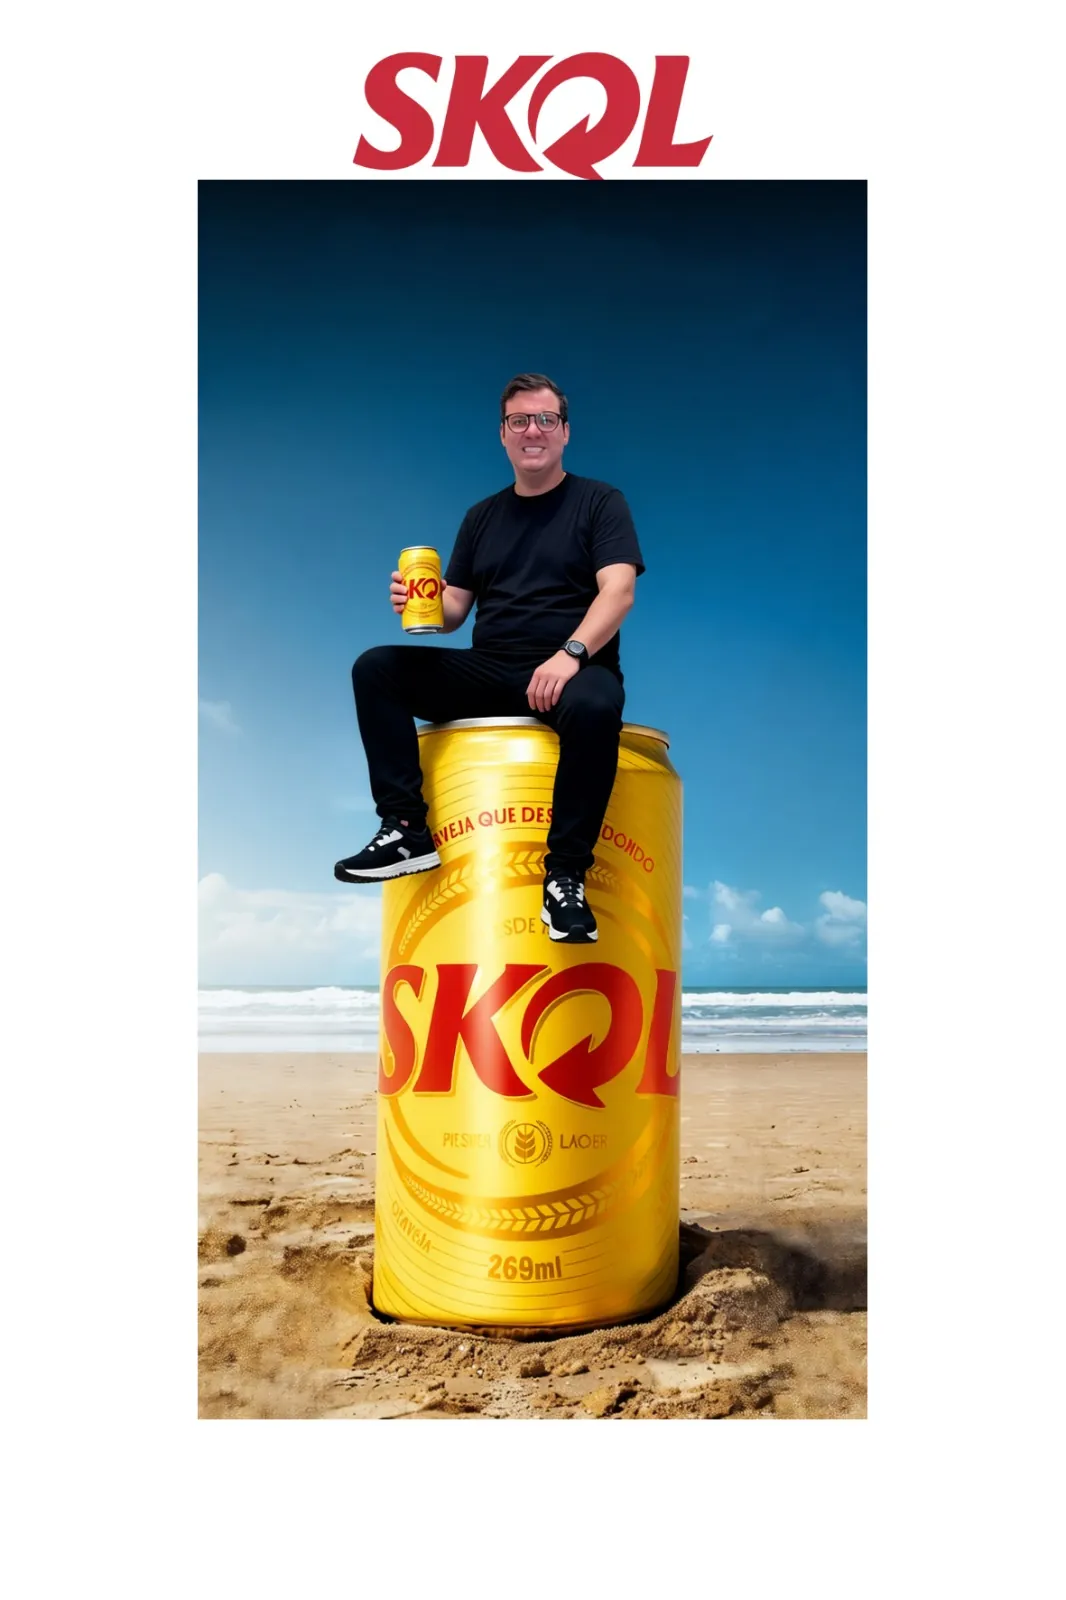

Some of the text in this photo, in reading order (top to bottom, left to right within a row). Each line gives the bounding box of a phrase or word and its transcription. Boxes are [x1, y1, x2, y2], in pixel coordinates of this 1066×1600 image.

[432, 806, 655, 873] RVEJA QUE DES DONDO
[488, 1254, 562, 1281] 269ml
